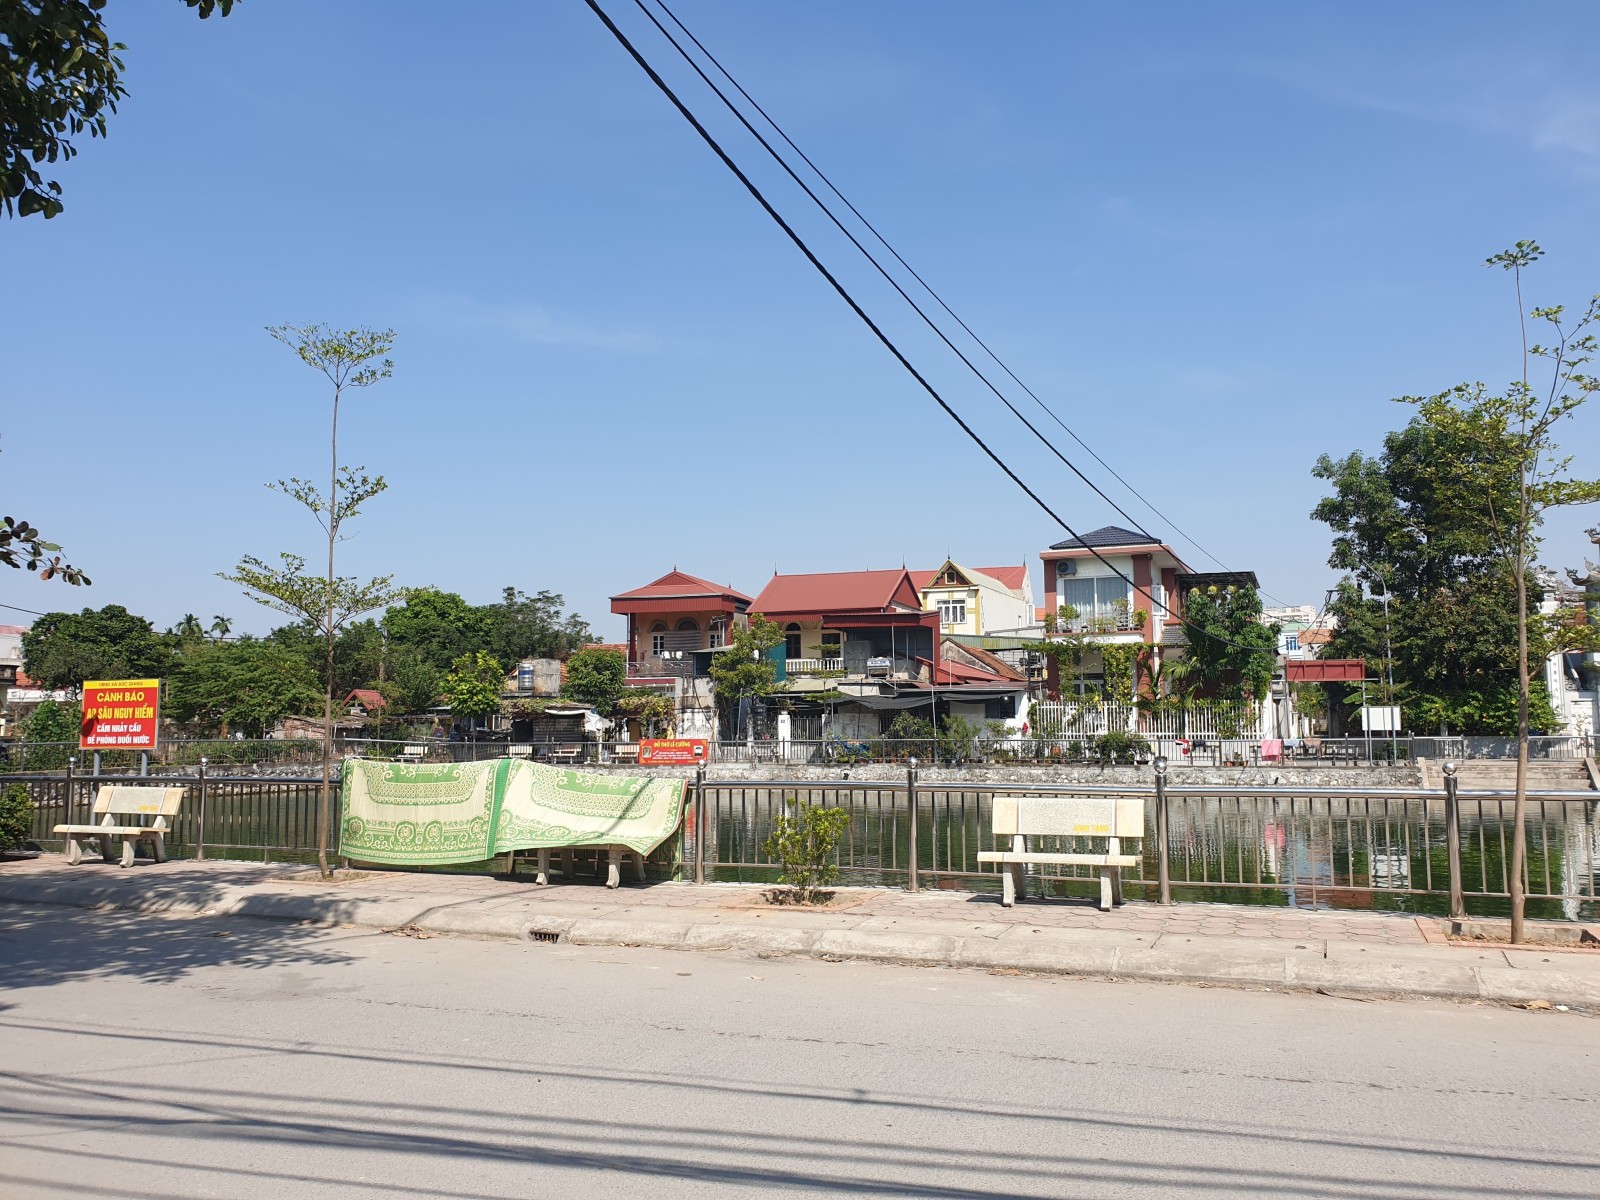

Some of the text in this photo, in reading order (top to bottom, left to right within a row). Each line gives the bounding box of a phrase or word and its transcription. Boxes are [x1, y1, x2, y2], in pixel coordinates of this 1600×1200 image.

[97, 690, 145, 702] CẢNH BÁO
[98, 706, 113, 719] SÂU
[114, 707, 134, 719] NGUY
[134, 703, 154, 719] HIỂM
[97, 723, 110, 732] CẤM
